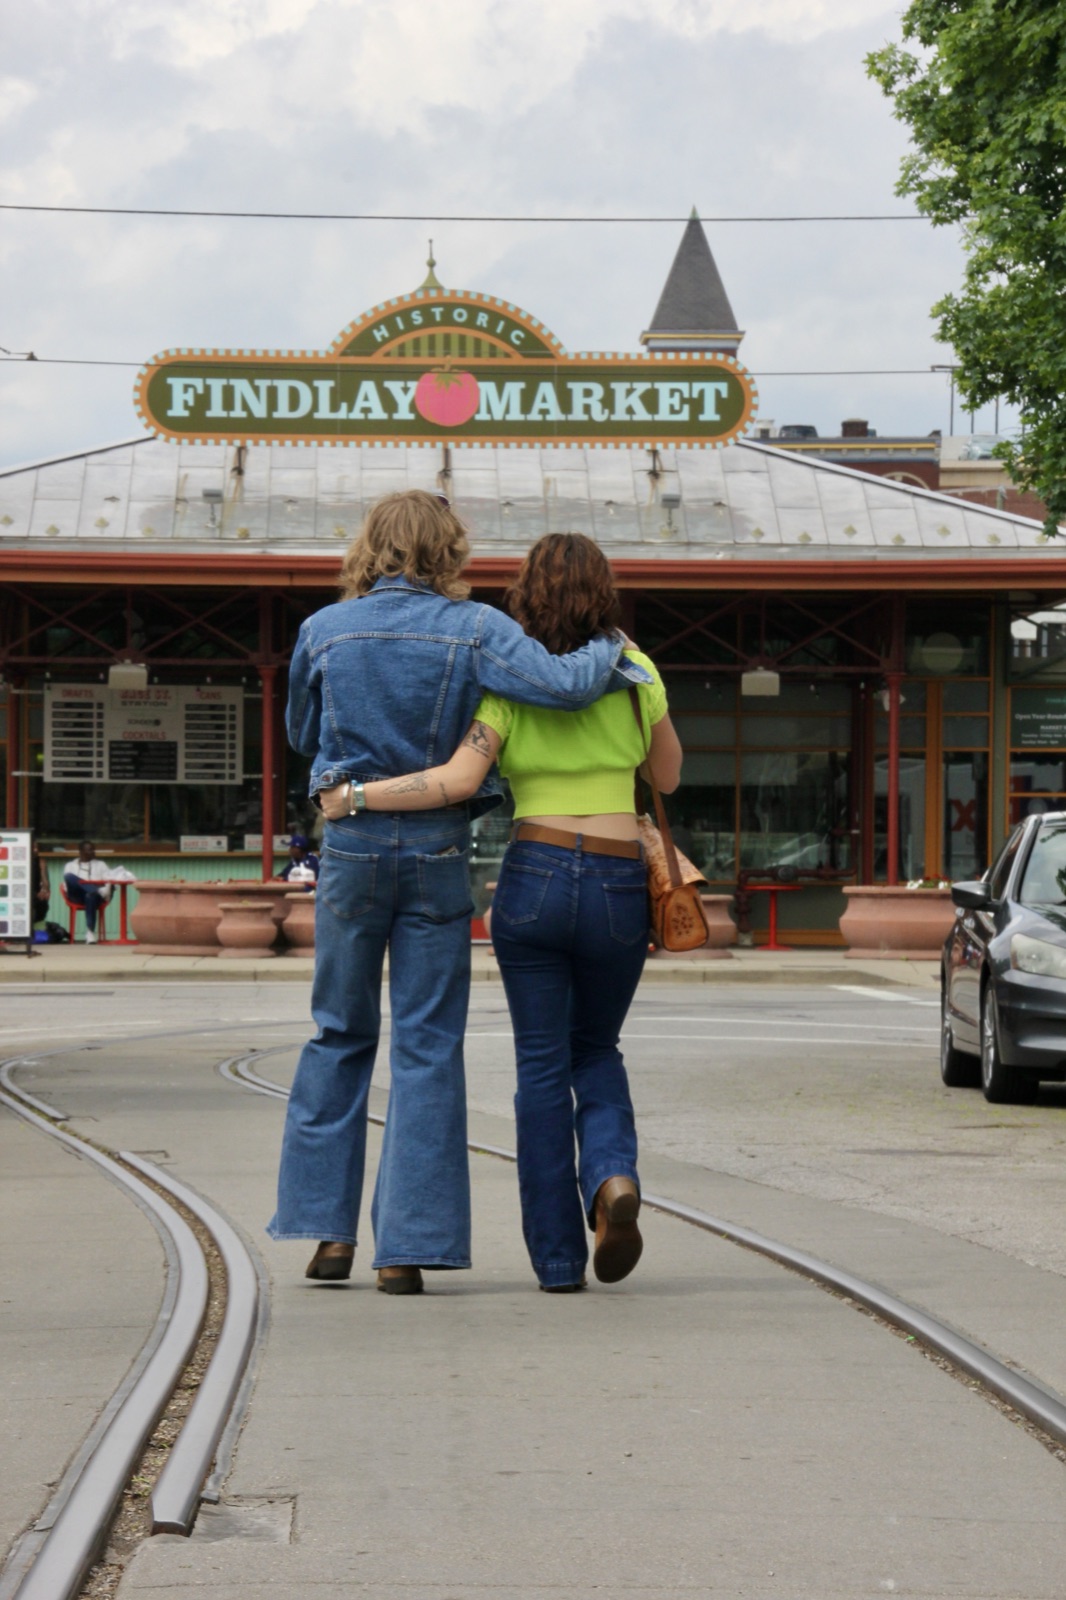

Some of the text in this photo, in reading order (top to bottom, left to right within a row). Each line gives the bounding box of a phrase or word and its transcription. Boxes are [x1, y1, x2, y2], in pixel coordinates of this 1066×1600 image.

[372, 307, 525, 346] HISTORIC
[166, 377, 728, 422] FINDLAY MARKET
[62, 689, 94, 698] DRAFTS
[122, 731, 166, 740] COCKTAILS
